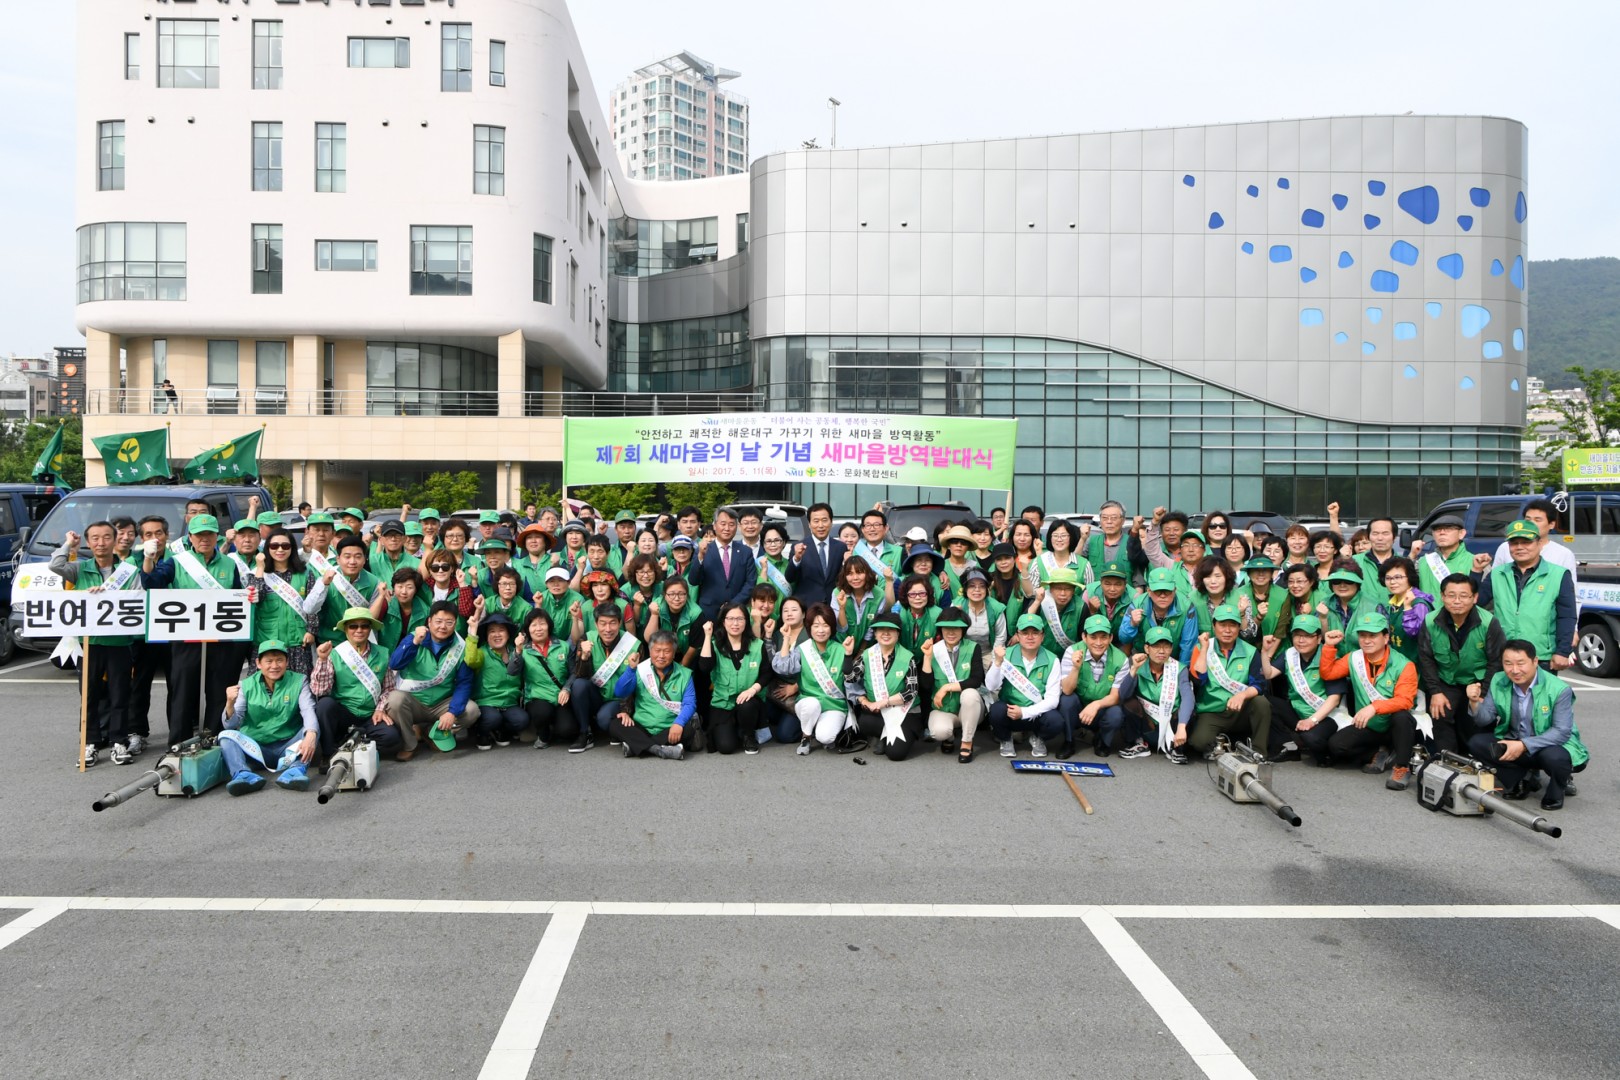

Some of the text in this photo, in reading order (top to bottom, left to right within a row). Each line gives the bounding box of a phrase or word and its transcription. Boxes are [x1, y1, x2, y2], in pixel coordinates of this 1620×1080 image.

[689, 428, 722, 439] 쾌적한
[728, 427, 773, 439] 해운대구
[779, 427, 813, 438] 가꾸기
[820, 428, 842, 439] 위한
[849, 428, 883, 440] 새마을
[596, 444, 641, 465] 제7회
[649, 442, 730, 464] 새마을의
[740, 441, 761, 462] 날
[770, 441, 812, 463] 기념
[844, 468, 898, 479] 문화복합센터
[32, 575, 59, 587] 우1동
[154, 601, 247, 633] 우1동
